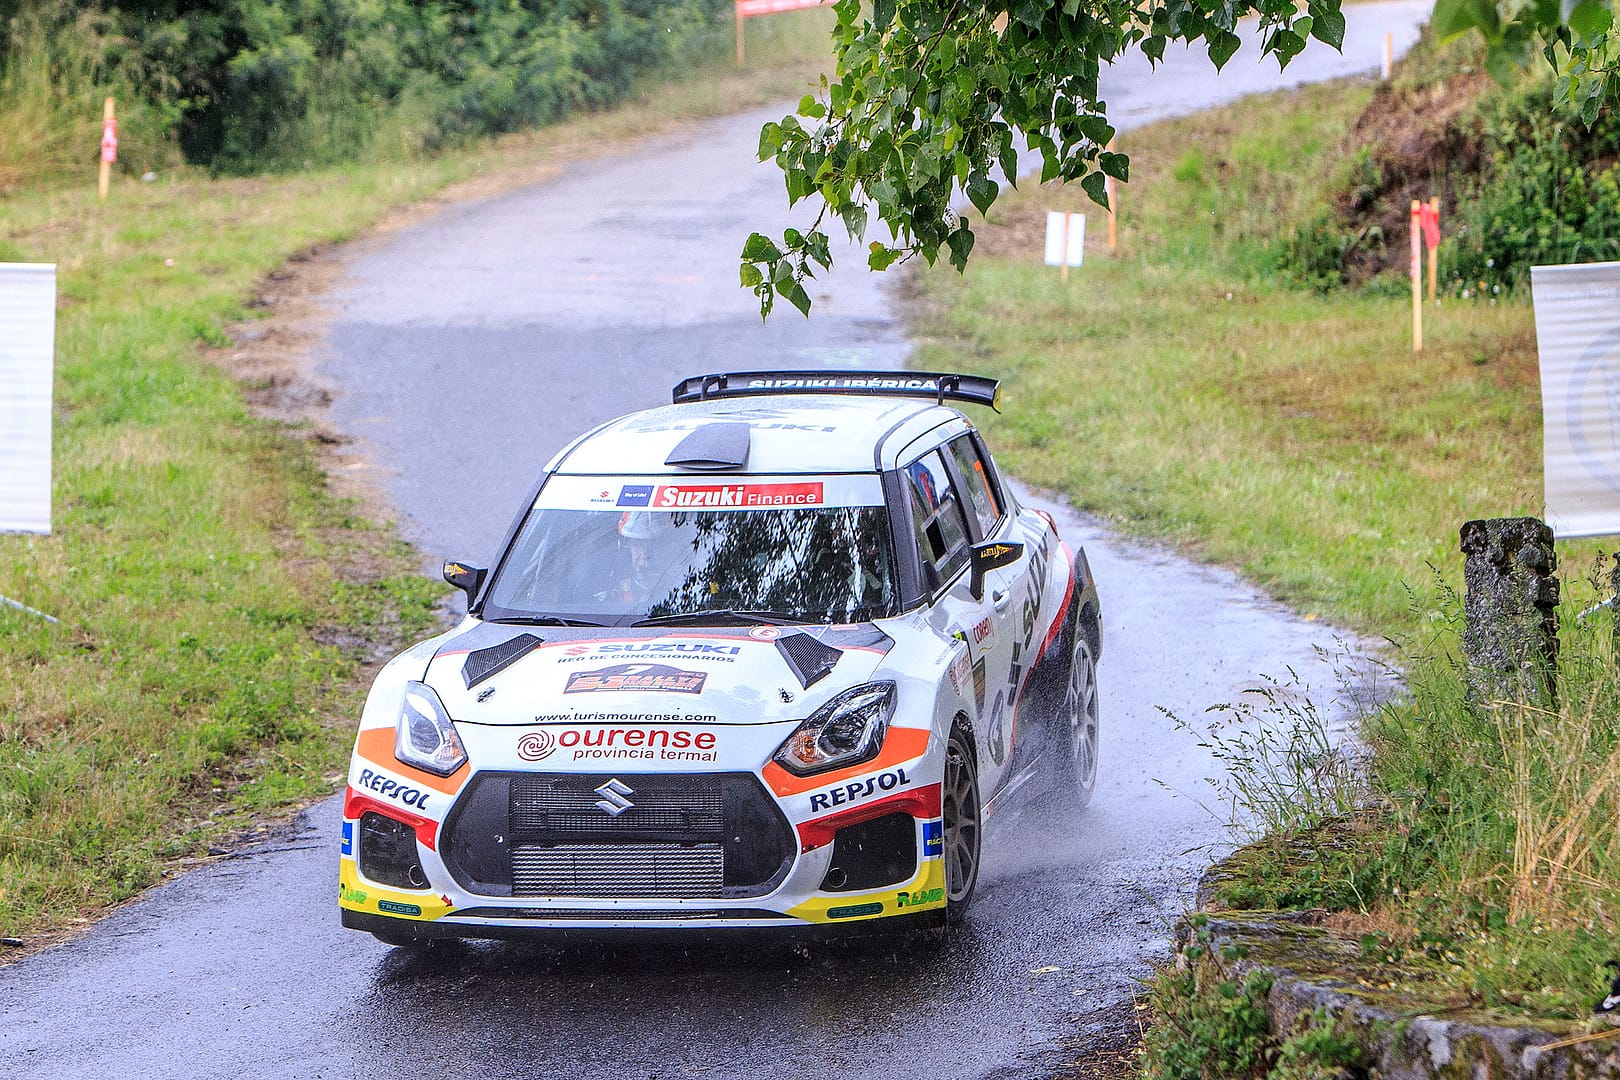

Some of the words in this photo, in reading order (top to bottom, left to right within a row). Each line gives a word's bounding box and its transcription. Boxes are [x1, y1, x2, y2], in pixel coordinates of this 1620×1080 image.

[748, 379, 836, 389] SUZUKI
[843, 377, 938, 390] IBÉRICA
[661, 486, 744, 506] Suzuki
[747, 493, 817, 505] Finance
[598, 644, 741, 655] SUZUKI
[557, 656, 585, 664] RED
[612, 653, 735, 663] CONCESIONARIOS
[534, 712, 717, 722] www.turismourense.com
[528, 742, 544, 750] ou
[559, 729, 717, 750] ourense
[573, 747, 654, 762] provincia
[660, 748, 718, 762] termal
[358, 768, 431, 811] REPSOL
[809, 768, 911, 813] REPSOL
[381, 903, 418, 914] TRADISA
[830, 906, 880, 917] TRADISA
